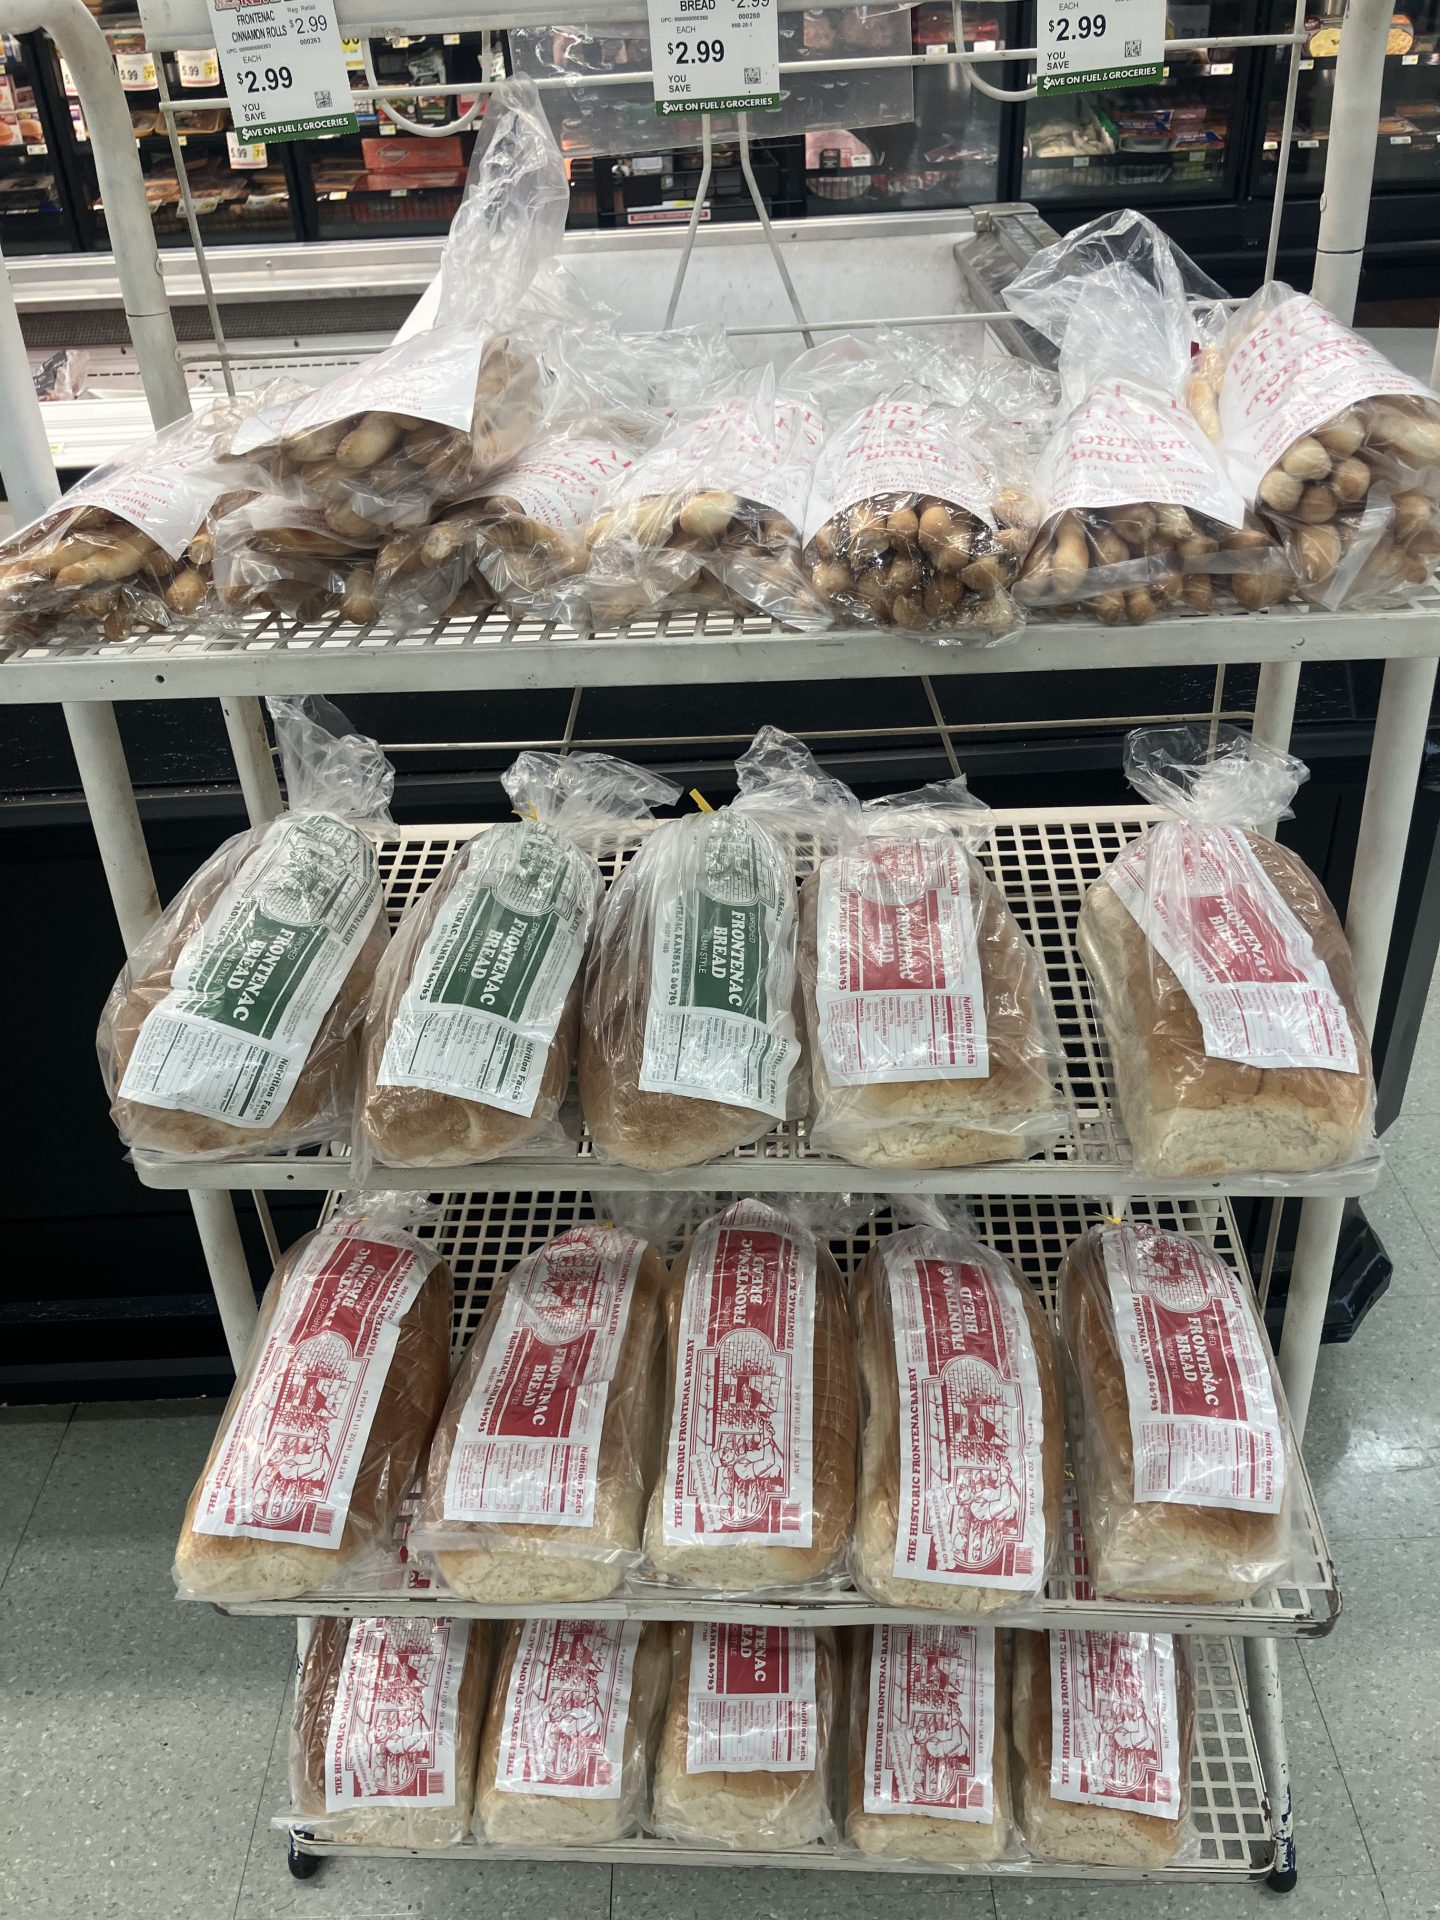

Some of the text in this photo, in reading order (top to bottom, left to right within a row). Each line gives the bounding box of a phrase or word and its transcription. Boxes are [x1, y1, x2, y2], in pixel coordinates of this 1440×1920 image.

[237, 11, 275, 26] FRONTENAC
[680, 0, 716, 12] BREAD
[1058, 2, 1078, 10] EACH
[232, 26, 287, 42] CINNAMON ROLLS
[289, 15, 328, 34] $2.99
[676, 26, 696, 34] EACH
[1048, 14, 1106, 41] $2.99
[242, 55, 262, 64] EACH
[668, 40, 724, 64] $2.99
[1047, 52, 1066, 60] YOU
[1047, 61, 1069, 70] SAVE
[120, 70, 138, 80] 5.99
[182, 66, 200, 76] 5.99
[237, 66, 292, 93] $2.99
[668, 84, 691, 92] SAVE
[1066, 75, 1080, 84] ON
[1082, 73, 1102, 82] FUEL
[1102, 72, 1108, 80] &
[1108, 66, 1156, 80] GROCERIES
[242, 103, 260, 112] YOU
[244, 112, 266, 122] SAVE
[684, 102, 698, 110] ON
[700, 100, 719, 110] FUEL
[720, 100, 726, 108] &
[726, 98, 772, 108] GROCERIES
[264, 125, 277, 134] ON
[278, 124, 296, 133] FUEL
[298, 123, 303, 132] &
[303, 118, 348, 130] GROCERIES
[286, 931, 307, 961] ENRICHED
[878, 923, 894, 962] BREAD
[1207, 910, 1246, 959] BREAD
[1215, 892, 1275, 981] FRONTENAC
[225, 936, 265, 992] BREAD
[418, 937, 453, 1001] KANSAS 66763
[457, 952, 472, 973] STYLE
[469, 928, 502, 981] BREAD
[479, 916, 528, 1007] FRONTENAC
[671, 933, 682, 973] KANSAS
[697, 951, 707, 973] STYLE
[710, 926, 728, 978] BREAD
[726, 910, 746, 1005] FRONTENAC
[213, 960, 231, 985] STYLE
[231, 925, 294, 1023] FRONTENAC
[963, 996, 974, 1064] Nutrition Facts
[252, 1056, 290, 1123] Nutrition Facts
[510, 1074, 526, 1100] Facts
[319, 1245, 371, 1329] FRONTENAC
[342, 1261, 375, 1310] BREAD
[732, 1238, 754, 1325] FRONTENAC
[749, 1255, 765, 1304] BREAD
[310, 1296, 329, 1332] ENRICHED
[785, 1292, 796, 1349] FRONTENAC,
[941, 1265, 964, 1351] FRONTENAC
[960, 1286, 978, 1334] BREAD
[1204, 1313, 1217, 1345] ENRICHED
[1131, 1296, 1148, 1346] FRONTENAC,
[1147, 1381, 1158, 1411] 66763
[1175, 1333, 1197, 1382] BREAD
[1187, 1315, 1219, 1406] FRONTENAC
[476, 1329, 519, 1433] FRONTENAC, KANSAS 66763
[509, 1387, 522, 1406] STYLE
[521, 1363, 546, 1407] BREAD
[531, 1346, 567, 1427] FRONTNAC
[907, 1366, 919, 1404] BAERY
[358, 1395, 368, 1409] 454
[348, 1430, 357, 1442] OZ.
[352, 1422, 360, 1430] (1
[674, 1338, 695, 1527] THE HISTORIC FRONTENAC BAKERY
[908, 1406, 921, 1474] FRONTENAC
[341, 1452, 350, 1466] WT.
[346, 1442, 353, 1451] 16
[337, 1466, 346, 1480] NET
[1262, 1431, 1272, 1500] Nutriton Facts
[205, 1489, 221, 1516] THE
[573, 1488, 584, 1514] Facts
[695, 1457, 715, 1525] NO PRESERVATIVES
[909, 1476, 920, 1535] HISTORIC
[906, 1538, 918, 1562] THE
[941, 1552, 949, 1564] NO
[515, 1634, 536, 1695] FRONTENAC
[754, 1625, 767, 1682] TENAC
[876, 1656, 887, 1718] FRONTENAC
[1059, 1644, 1069, 1705] FRONTENAC
[508, 1696, 523, 1749] HISTORIC
[1061, 1708, 1069, 1759] HISTORIC
[505, 1751, 516, 1775] THE
[873, 1722, 884, 1771] HISTORIC
[891, 1735, 908, 1795] NO PRESERVATIVES
[1061, 1762, 1069, 1784] THE
[334, 1775, 342, 1795] THE
[873, 1774, 881, 1796] THE
